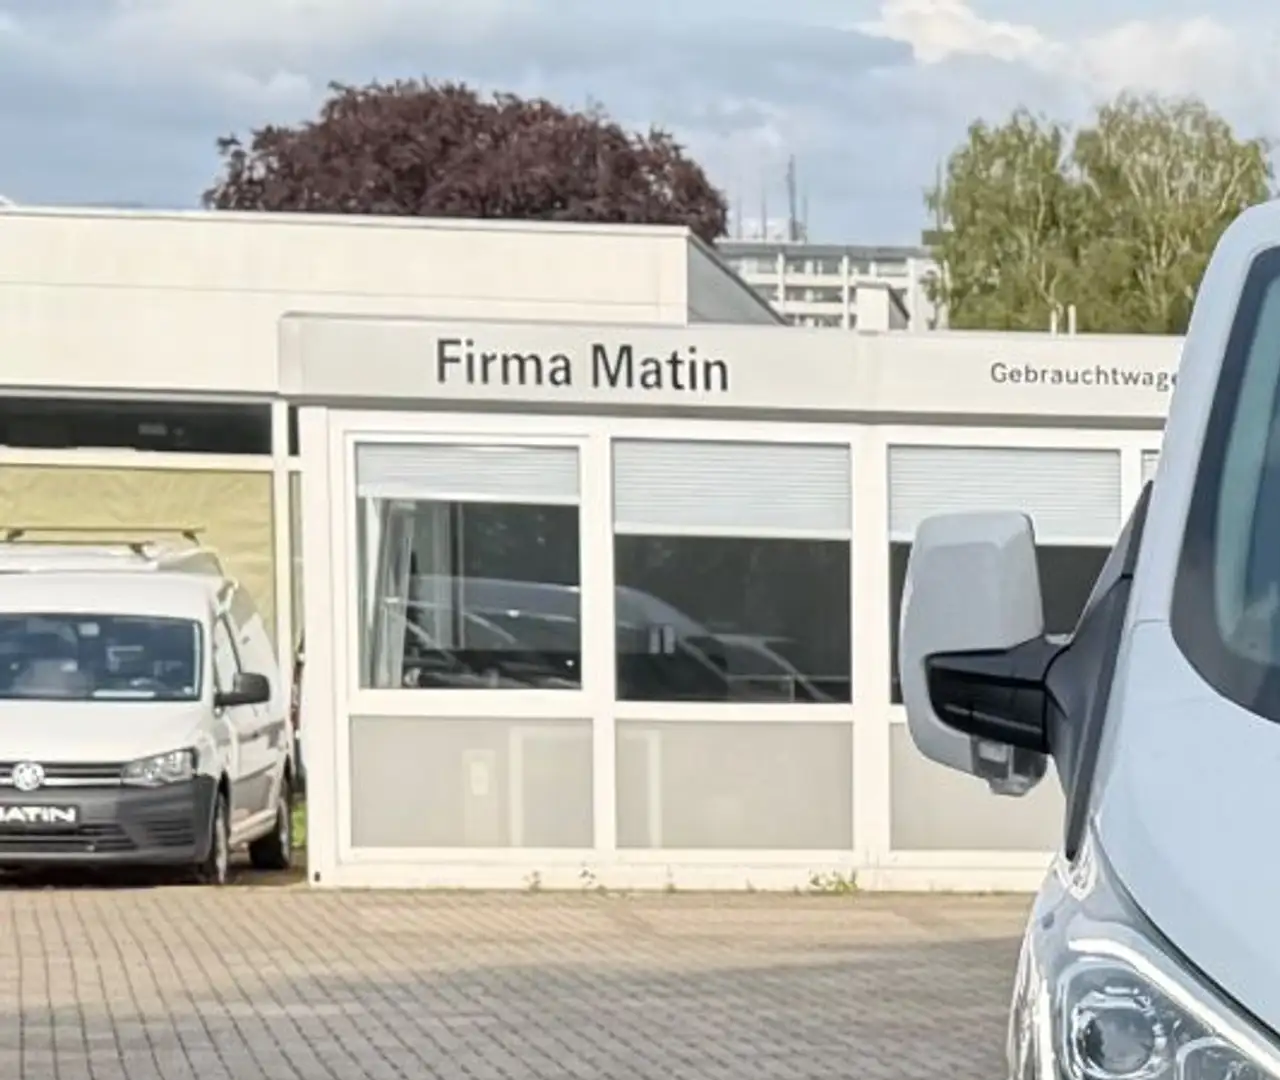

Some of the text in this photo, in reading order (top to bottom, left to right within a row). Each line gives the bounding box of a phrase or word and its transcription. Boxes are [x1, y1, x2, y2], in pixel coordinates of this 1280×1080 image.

[437, 337, 729, 392] Firma Matin
[0, 806, 76, 823] ATIN
